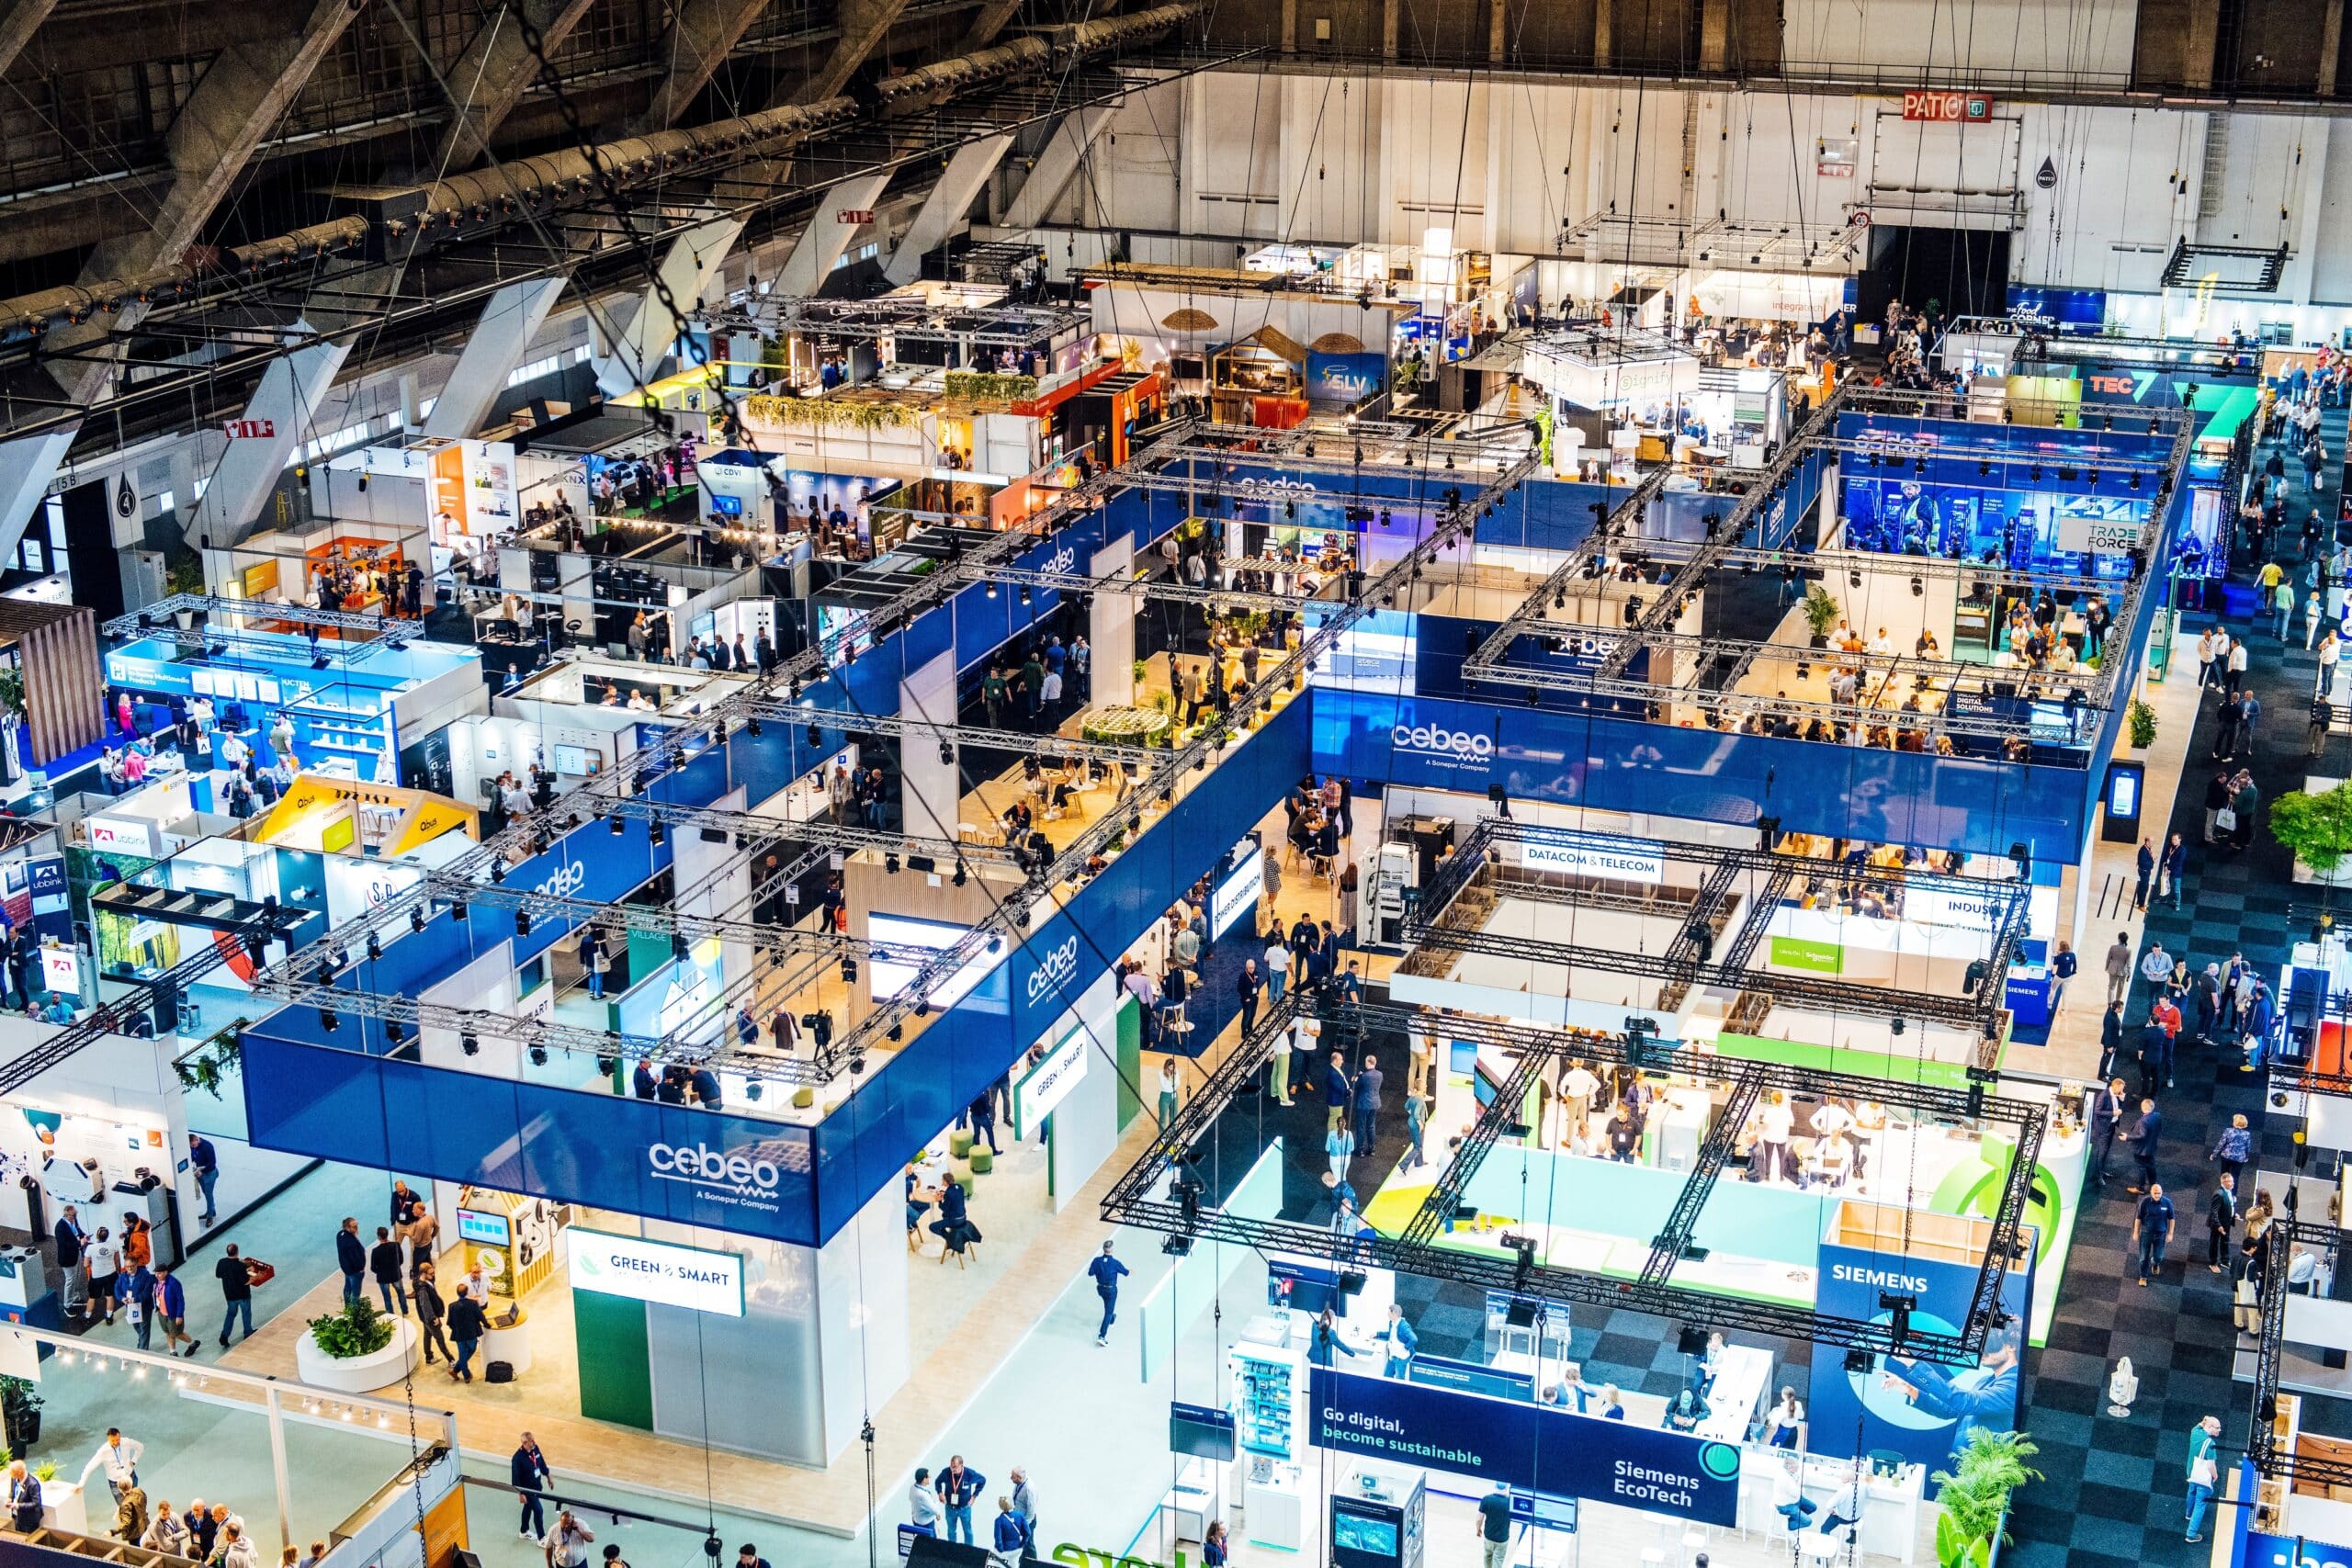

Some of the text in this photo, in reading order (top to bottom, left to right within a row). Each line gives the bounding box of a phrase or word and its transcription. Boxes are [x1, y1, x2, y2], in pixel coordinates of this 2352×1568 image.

[1904, 94, 1962, 118] PATIO
[1772, 301, 1823, 312] integratech
[2016, 301, 2042, 316] Food
[562, 472, 586, 484] KNX
[723, 468, 741, 477] CDVI
[2089, 525, 2137, 539] TRADE
[2088, 536, 2136, 550] FORCE
[1391, 723, 1492, 755] cebeo
[1431, 760, 1459, 769] Sonepar
[1459, 763, 1490, 773] Company
[297, 794, 315, 809] Qbus
[420, 818, 437, 832] Qbus
[116, 834, 146, 846] ubbink
[1528, 848, 1655, 874] DATACOM & TELECOM
[33, 877, 62, 889] ubbink
[630, 930, 667, 942] VILLAGE
[1027, 935, 1078, 998] cebeo
[2007, 986, 2039, 996] SIEMENS
[1038, 1070, 1057, 1097] GREEN
[1064, 1043, 1084, 1072] SMART
[649, 1142, 779, 1189] cebeo
[704, 1191, 739, 1205] Sonepar
[741, 1198, 780, 1213] Company
[610, 1255, 660, 1273] GREEN
[678, 1267, 729, 1286] SMART
[1832, 1264, 1928, 1292] SIEMENS
[1323, 1407, 1406, 1436] Go digital,
[1323, 1425, 1483, 1467] become sustainable
[1614, 1461, 1700, 1490] Siemens
[1613, 1479, 1692, 1508] EcoTech
